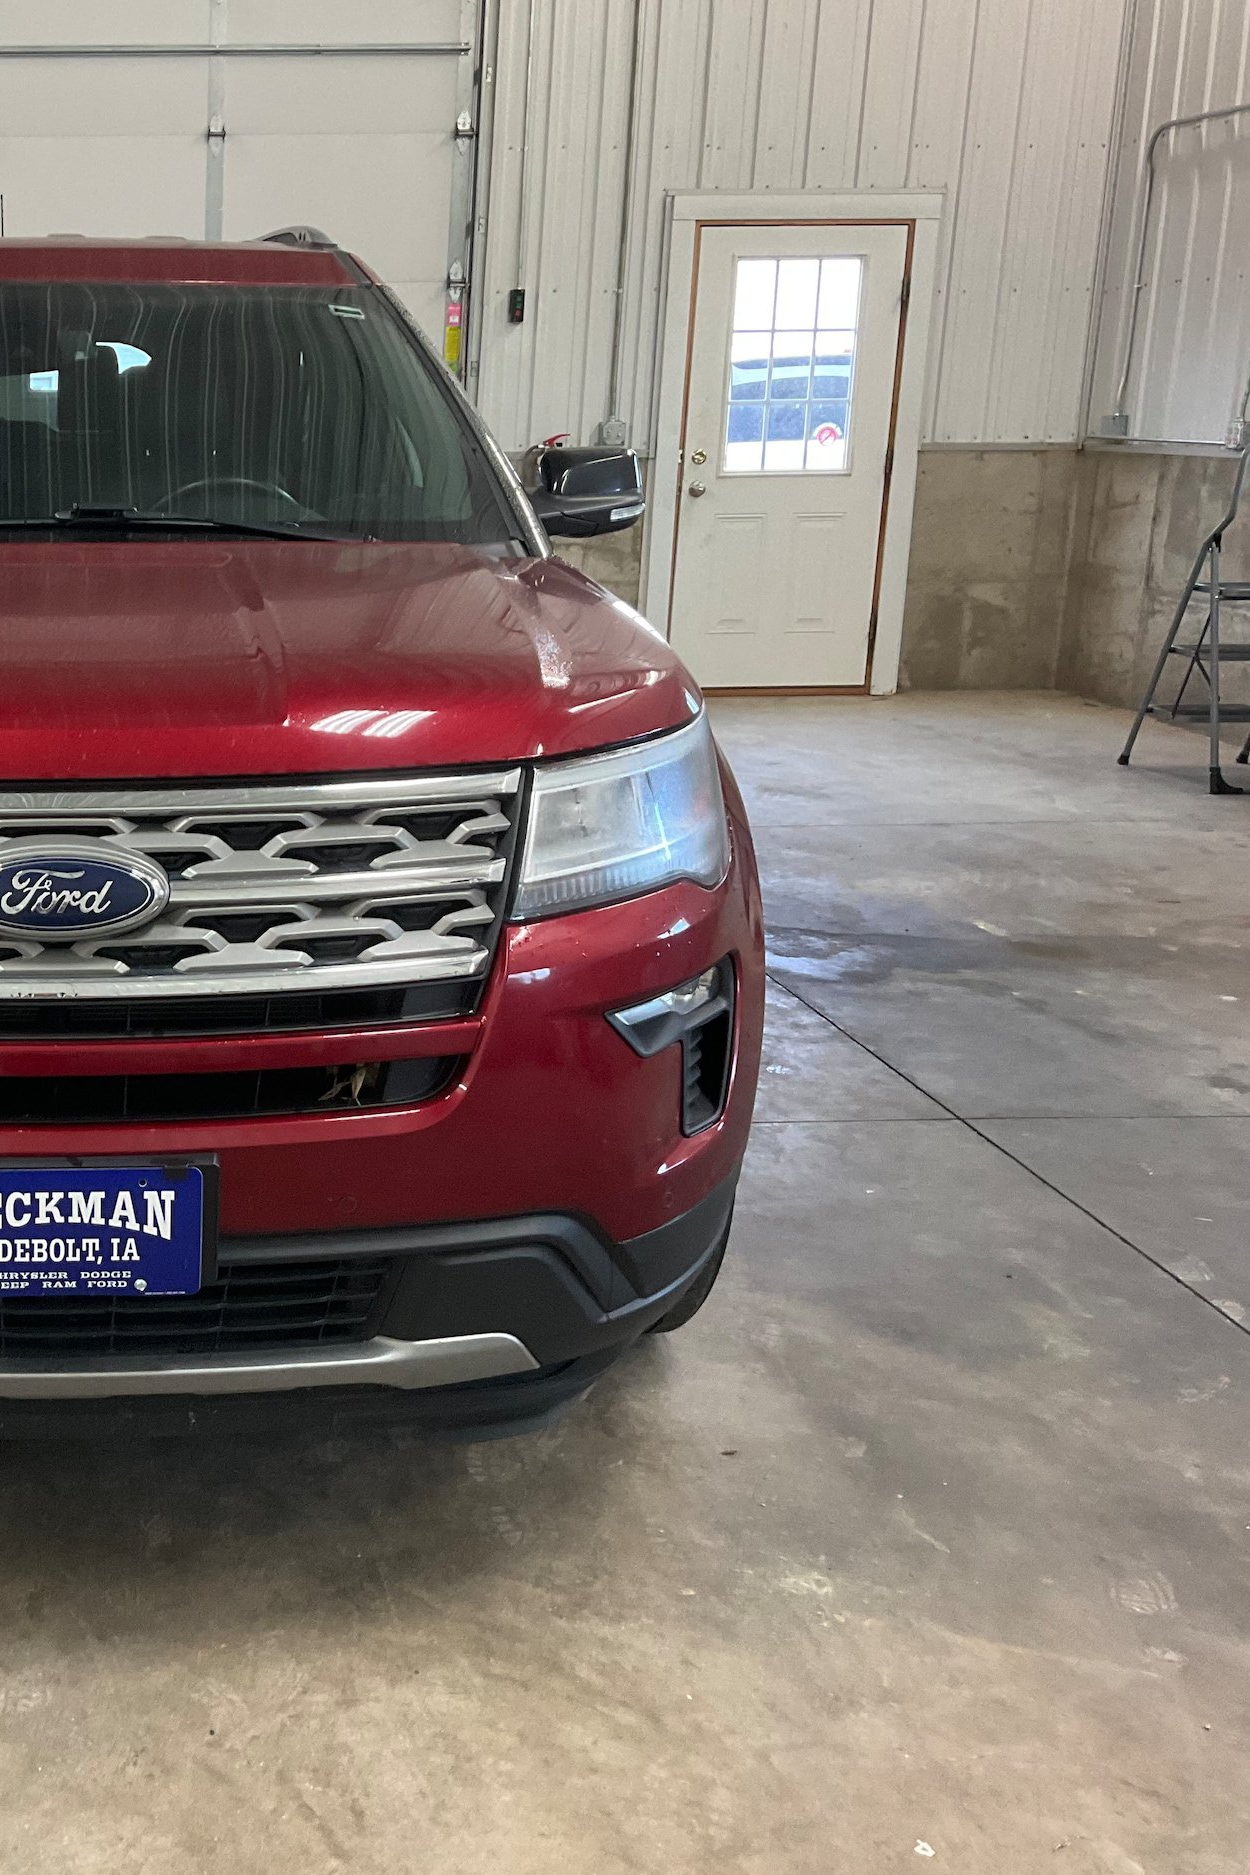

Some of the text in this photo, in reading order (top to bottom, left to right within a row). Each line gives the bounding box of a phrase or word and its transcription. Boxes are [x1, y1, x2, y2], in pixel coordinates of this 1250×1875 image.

[0, 868, 114, 915] Ford
[110, 1237, 140, 1262] IA
[80, 1270, 132, 1279] DODGE
[42, 1280, 78, 1289] RAM
[87, 1280, 128, 1288] FORD
